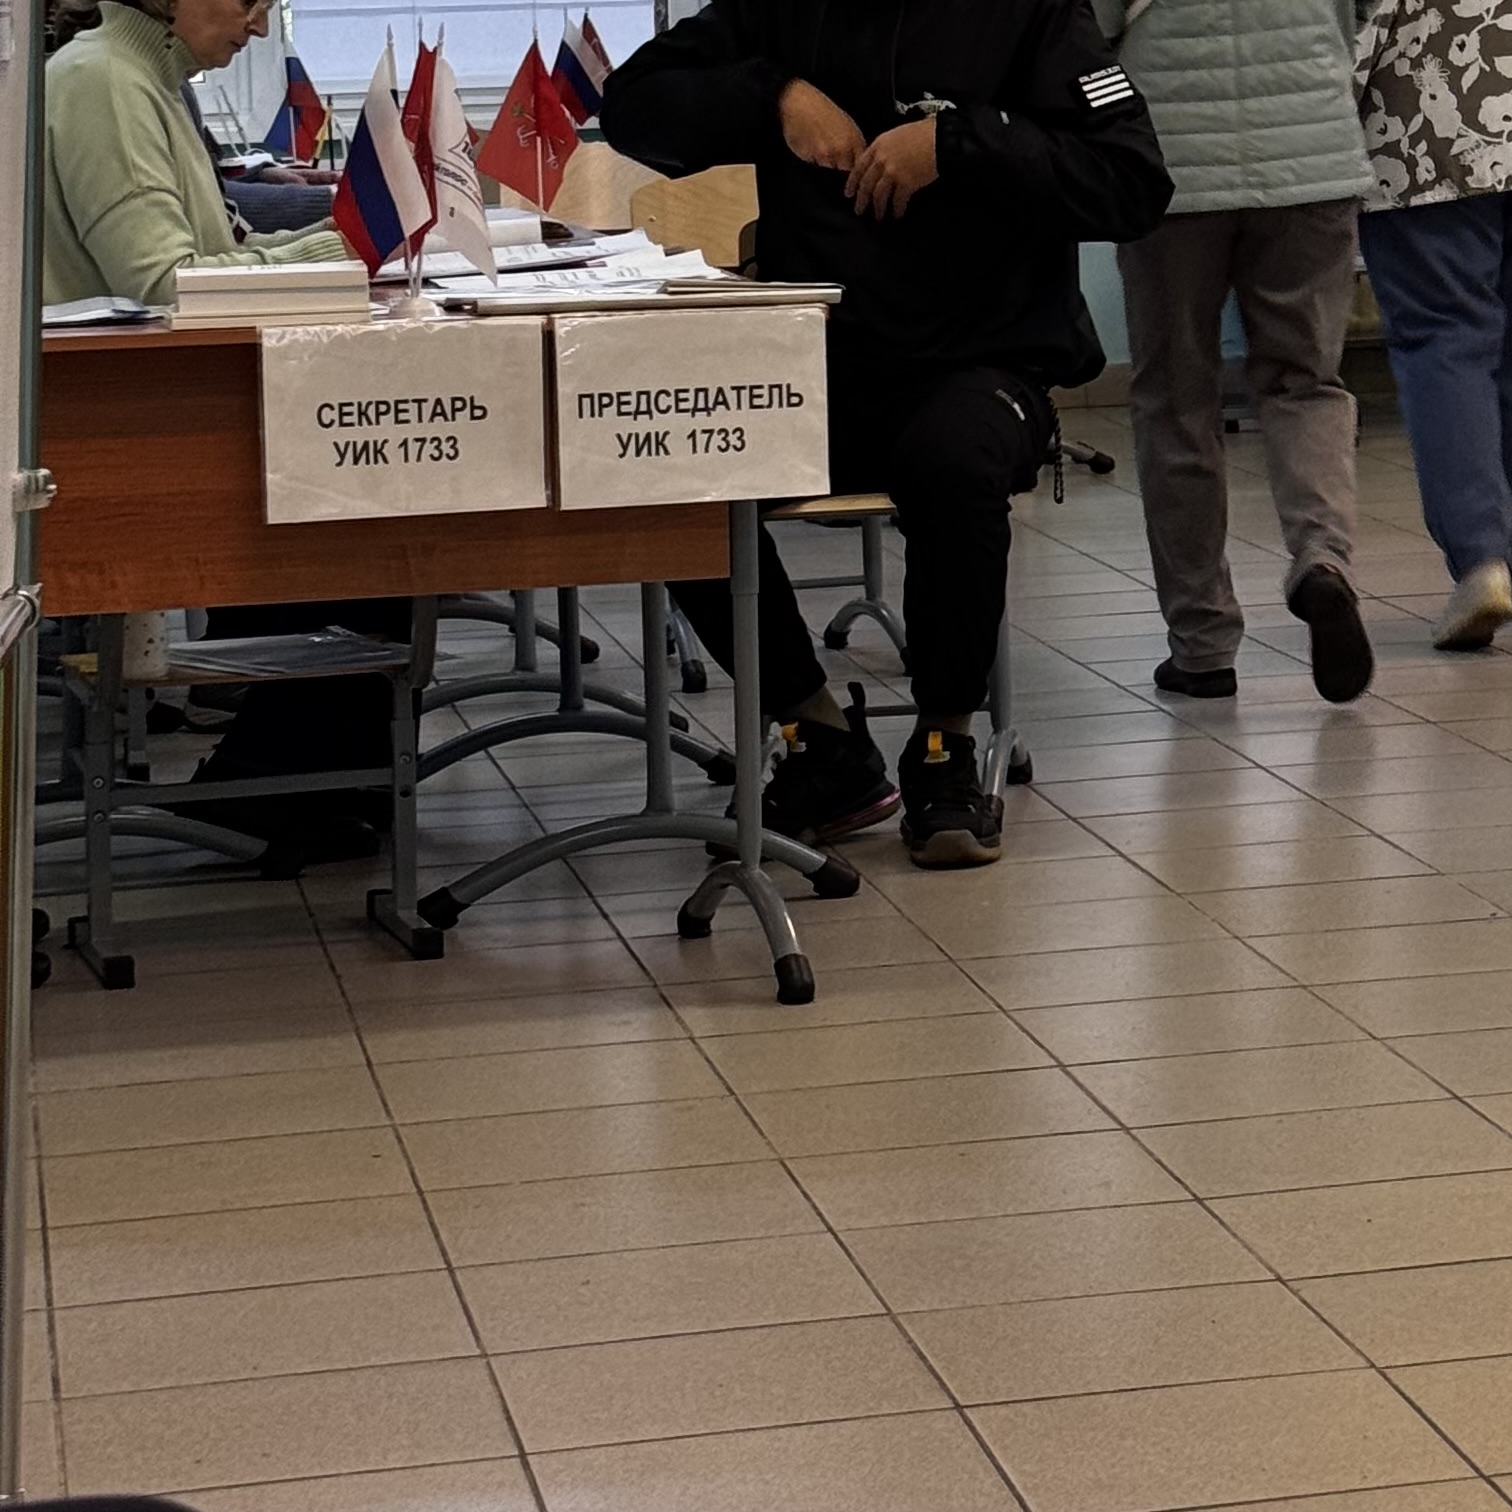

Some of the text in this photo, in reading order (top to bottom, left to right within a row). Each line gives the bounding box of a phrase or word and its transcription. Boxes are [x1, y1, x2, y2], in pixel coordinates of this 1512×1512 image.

[316, 395, 489, 430] СЕКРЕТАРЬ
[577, 383, 804, 420] ПРЕДСЕДАТЕЛЬ
[333, 434, 460, 468] УИК 1733
[615, 427, 747, 459] УИК 1733
